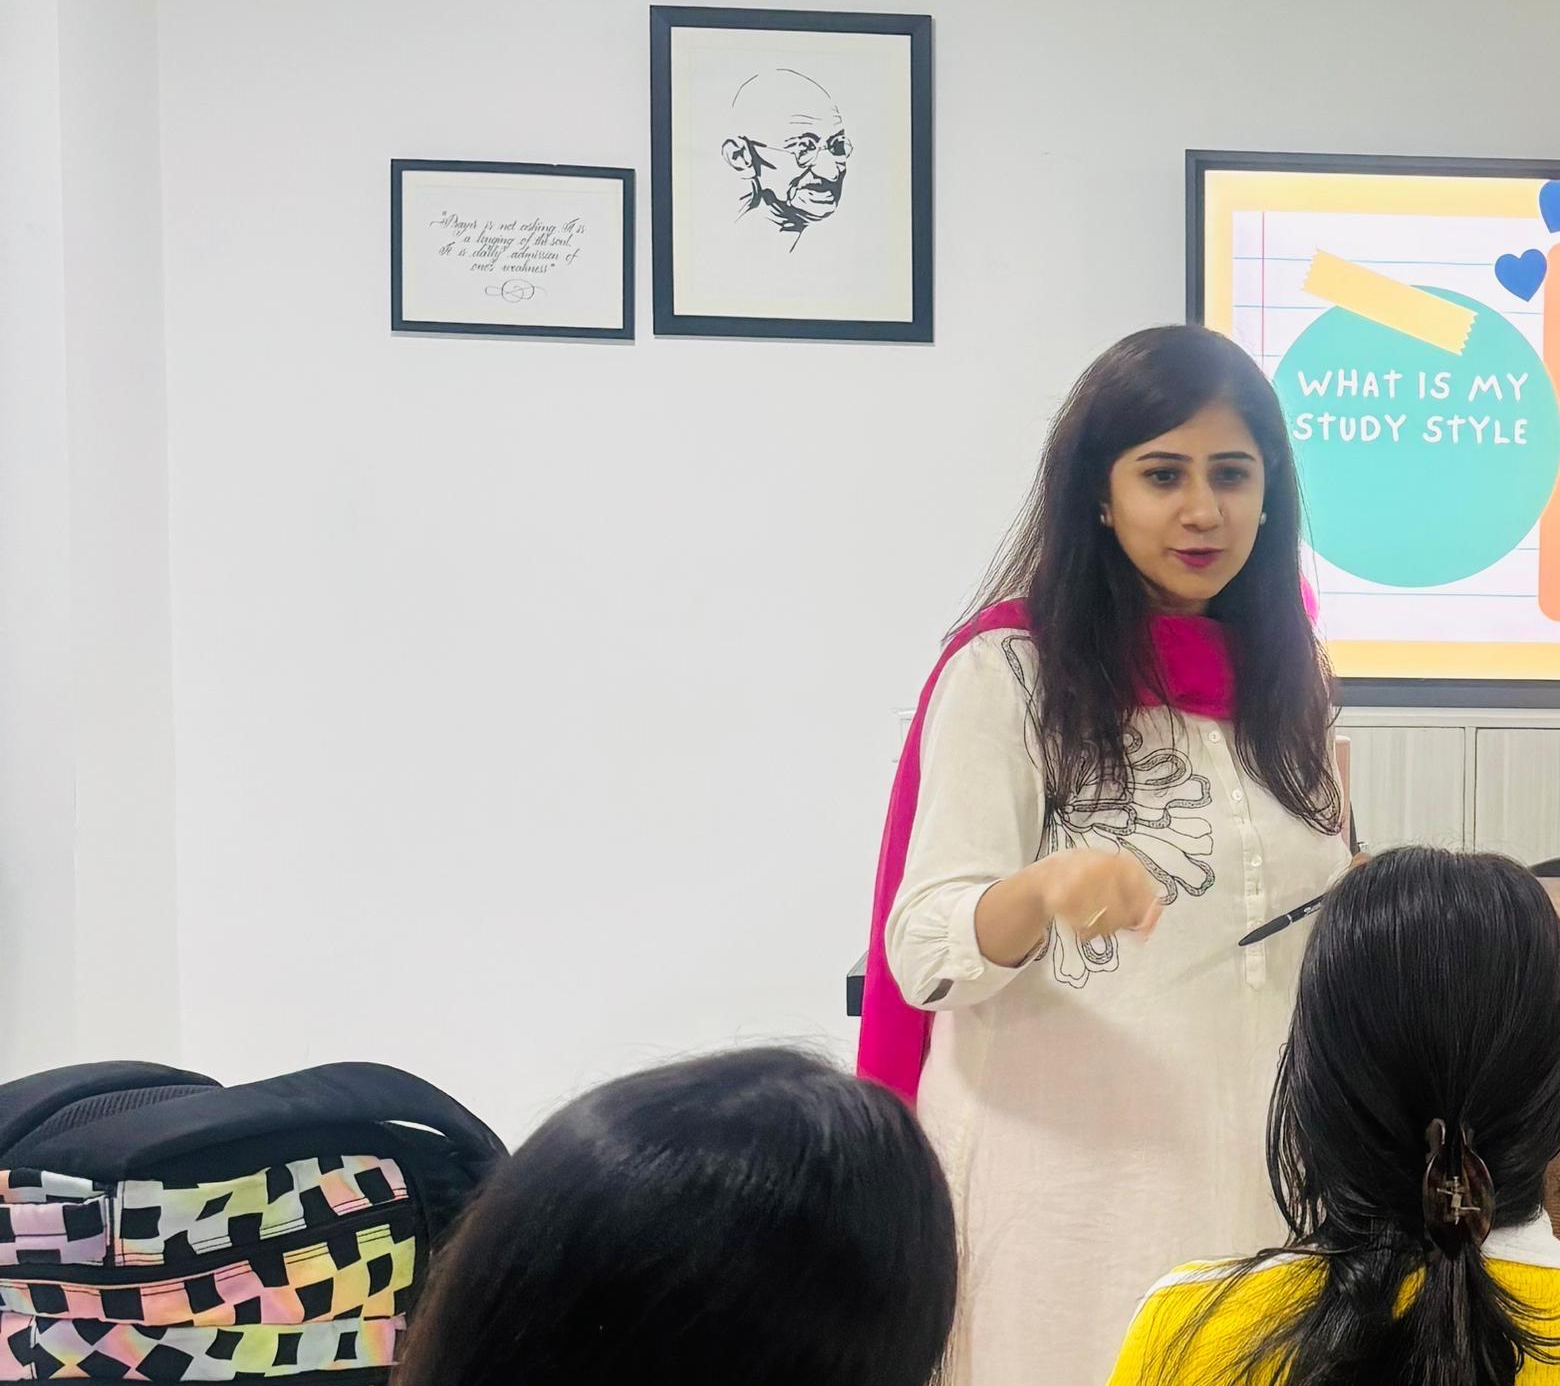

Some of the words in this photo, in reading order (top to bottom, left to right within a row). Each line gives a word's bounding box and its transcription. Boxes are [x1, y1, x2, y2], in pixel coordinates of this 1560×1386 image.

[1297, 369, 1403, 399] WHAT
[1418, 371, 1451, 399] IS
[1467, 372, 1529, 402] MY
[1292, 412, 1407, 443] STUDY
[1422, 414, 1528, 445] STYLE
